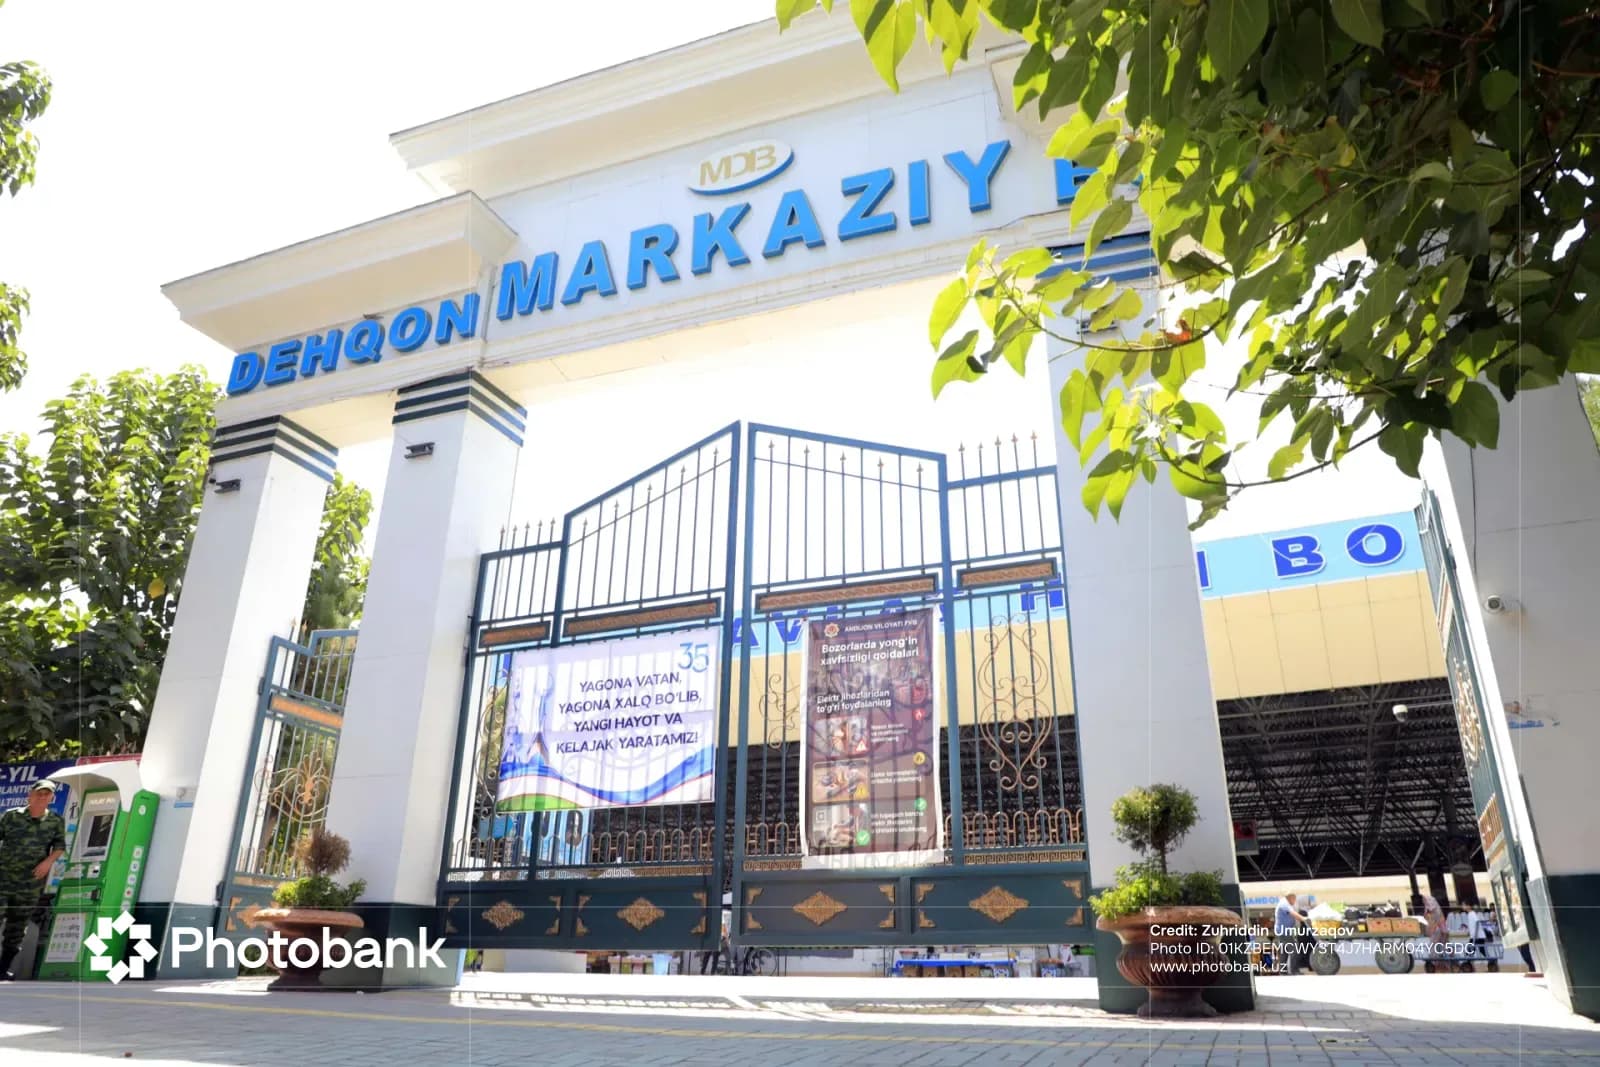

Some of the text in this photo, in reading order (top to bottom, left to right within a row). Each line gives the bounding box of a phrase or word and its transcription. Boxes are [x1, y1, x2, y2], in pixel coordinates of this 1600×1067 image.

[700, 144, 777, 186] MDB
[226, 139, 1012, 396] DEHQON MARKAZIY
[874, 620, 903, 630] VILOYATI
[820, 647, 919, 666] xavfsizligi qoidalari
[821, 640, 877, 654] Bozorlarda
[678, 642, 710, 673] 35
[579, 671, 682, 693] YAGONA VATAN,
[558, 699, 611, 714] YAGONA
[615, 695, 652, 710] XALQ
[842, 699, 892, 711] foydalaning
[574, 712, 683, 733] YANGI HAYOT VA
[556, 731, 698, 754] KELAJAK YARATAMIZ!
[0, 765, 40, 783] -YIL
